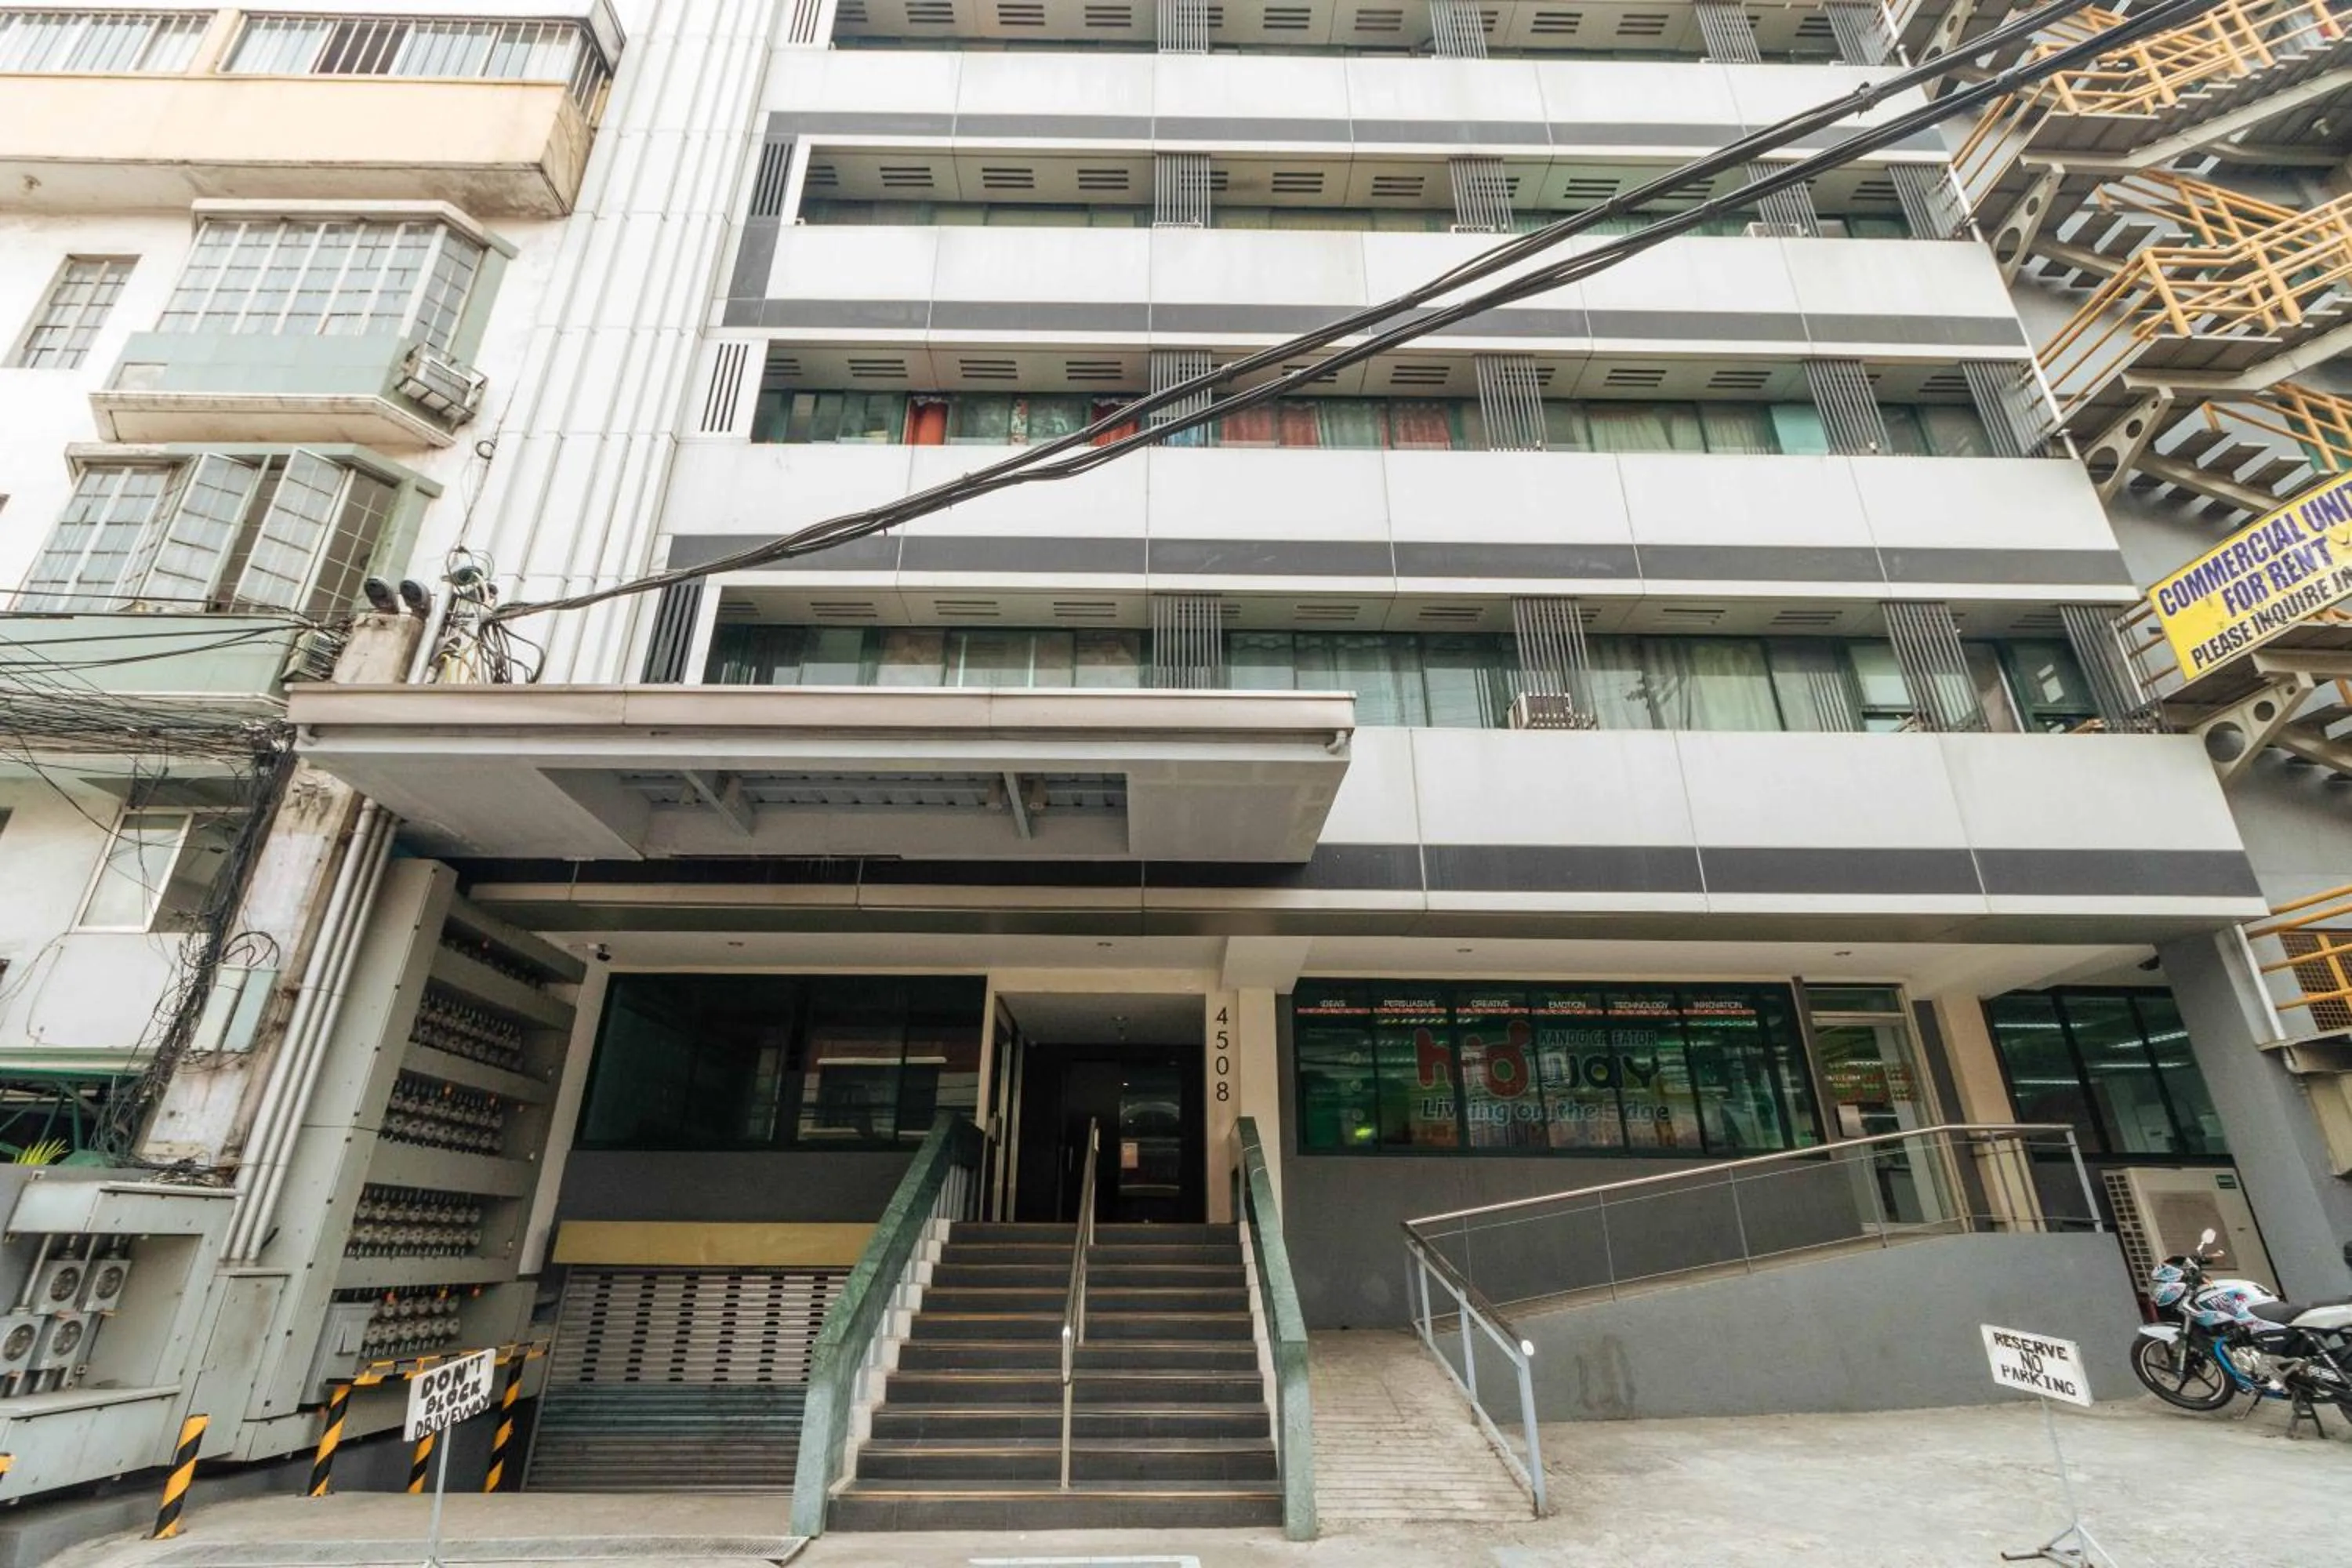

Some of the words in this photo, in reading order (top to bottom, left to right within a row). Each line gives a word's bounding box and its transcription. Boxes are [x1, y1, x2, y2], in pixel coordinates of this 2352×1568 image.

[2158, 512, 2307, 617] COMMERCIAL
[2221, 572, 2270, 618] FOR
[2266, 536, 2334, 592] RENT
[2191, 622, 2253, 670] PLEASE
[2249, 579, 2332, 636] INQUIRE
[1216, 1007, 1229, 1102] 4508
[1540, 1029, 1588, 1045] KANDO
[1592, 1029, 1656, 1046] CREATOR
[1423, 1098, 1510, 1125] Living
[1516, 1102, 1543, 1121] on
[1557, 1098, 1598, 1121] the
[1993, 1332, 2069, 1361] RESERVE
[2020, 1352, 2043, 1373] NO
[421, 1355, 485, 1399] DON'T
[425, 1377, 481, 1414] BLOCK
[2001, 1364, 2077, 1396] PARKING
[415, 1395, 490, 1437] DRIVEWAY
